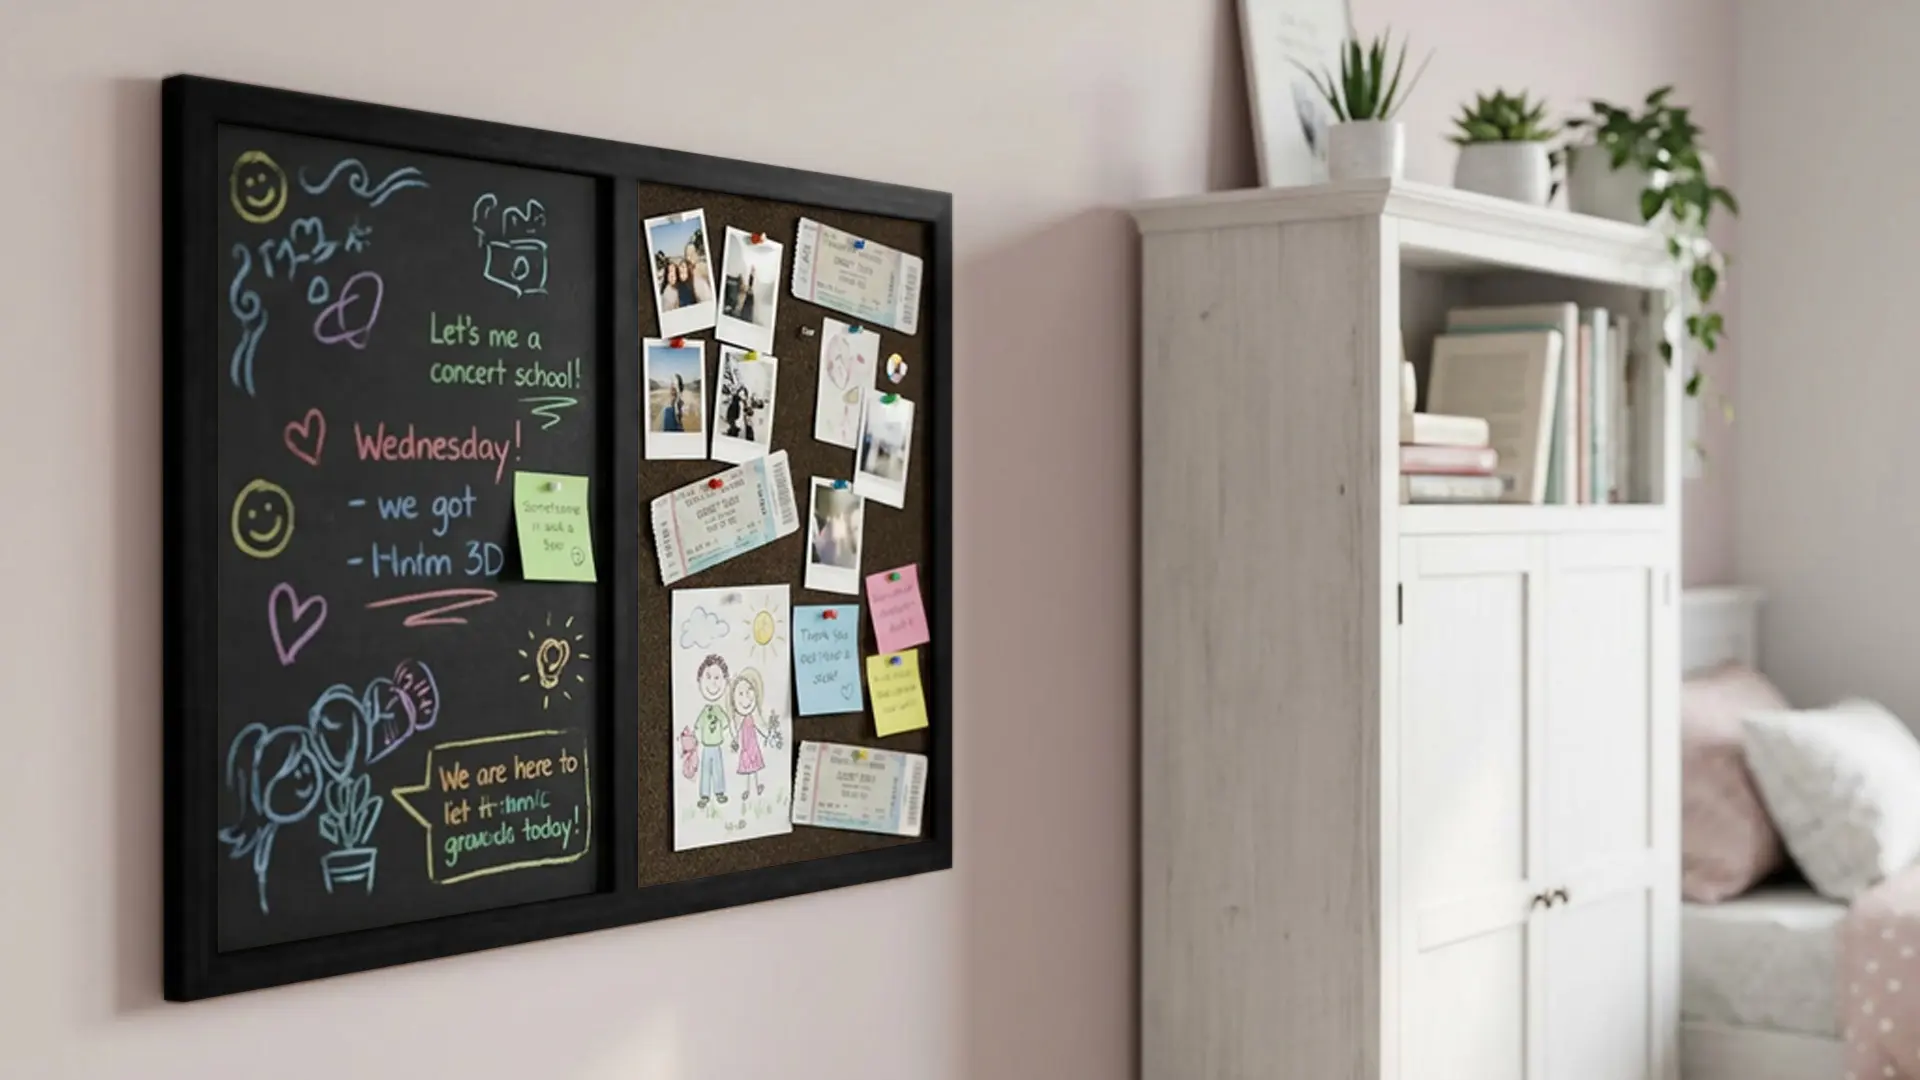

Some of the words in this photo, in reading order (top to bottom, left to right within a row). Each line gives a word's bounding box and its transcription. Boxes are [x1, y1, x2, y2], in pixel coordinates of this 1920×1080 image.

[431, 311, 480, 346] Let's
[488, 329, 519, 348] me
[527, 331, 543, 350] a
[430, 358, 507, 386] concert
[514, 357, 581, 389] school!
[354, 419, 521, 485] Wednesday!
[377, 496, 420, 519] we
[431, 484, 477, 537] got
[464, 539, 505, 577] 3D
[438, 761, 470, 792] We
[476, 764, 508, 786] are
[514, 755, 553, 780] here
[558, 747, 578, 774] to
[521, 805, 580, 850] today!
